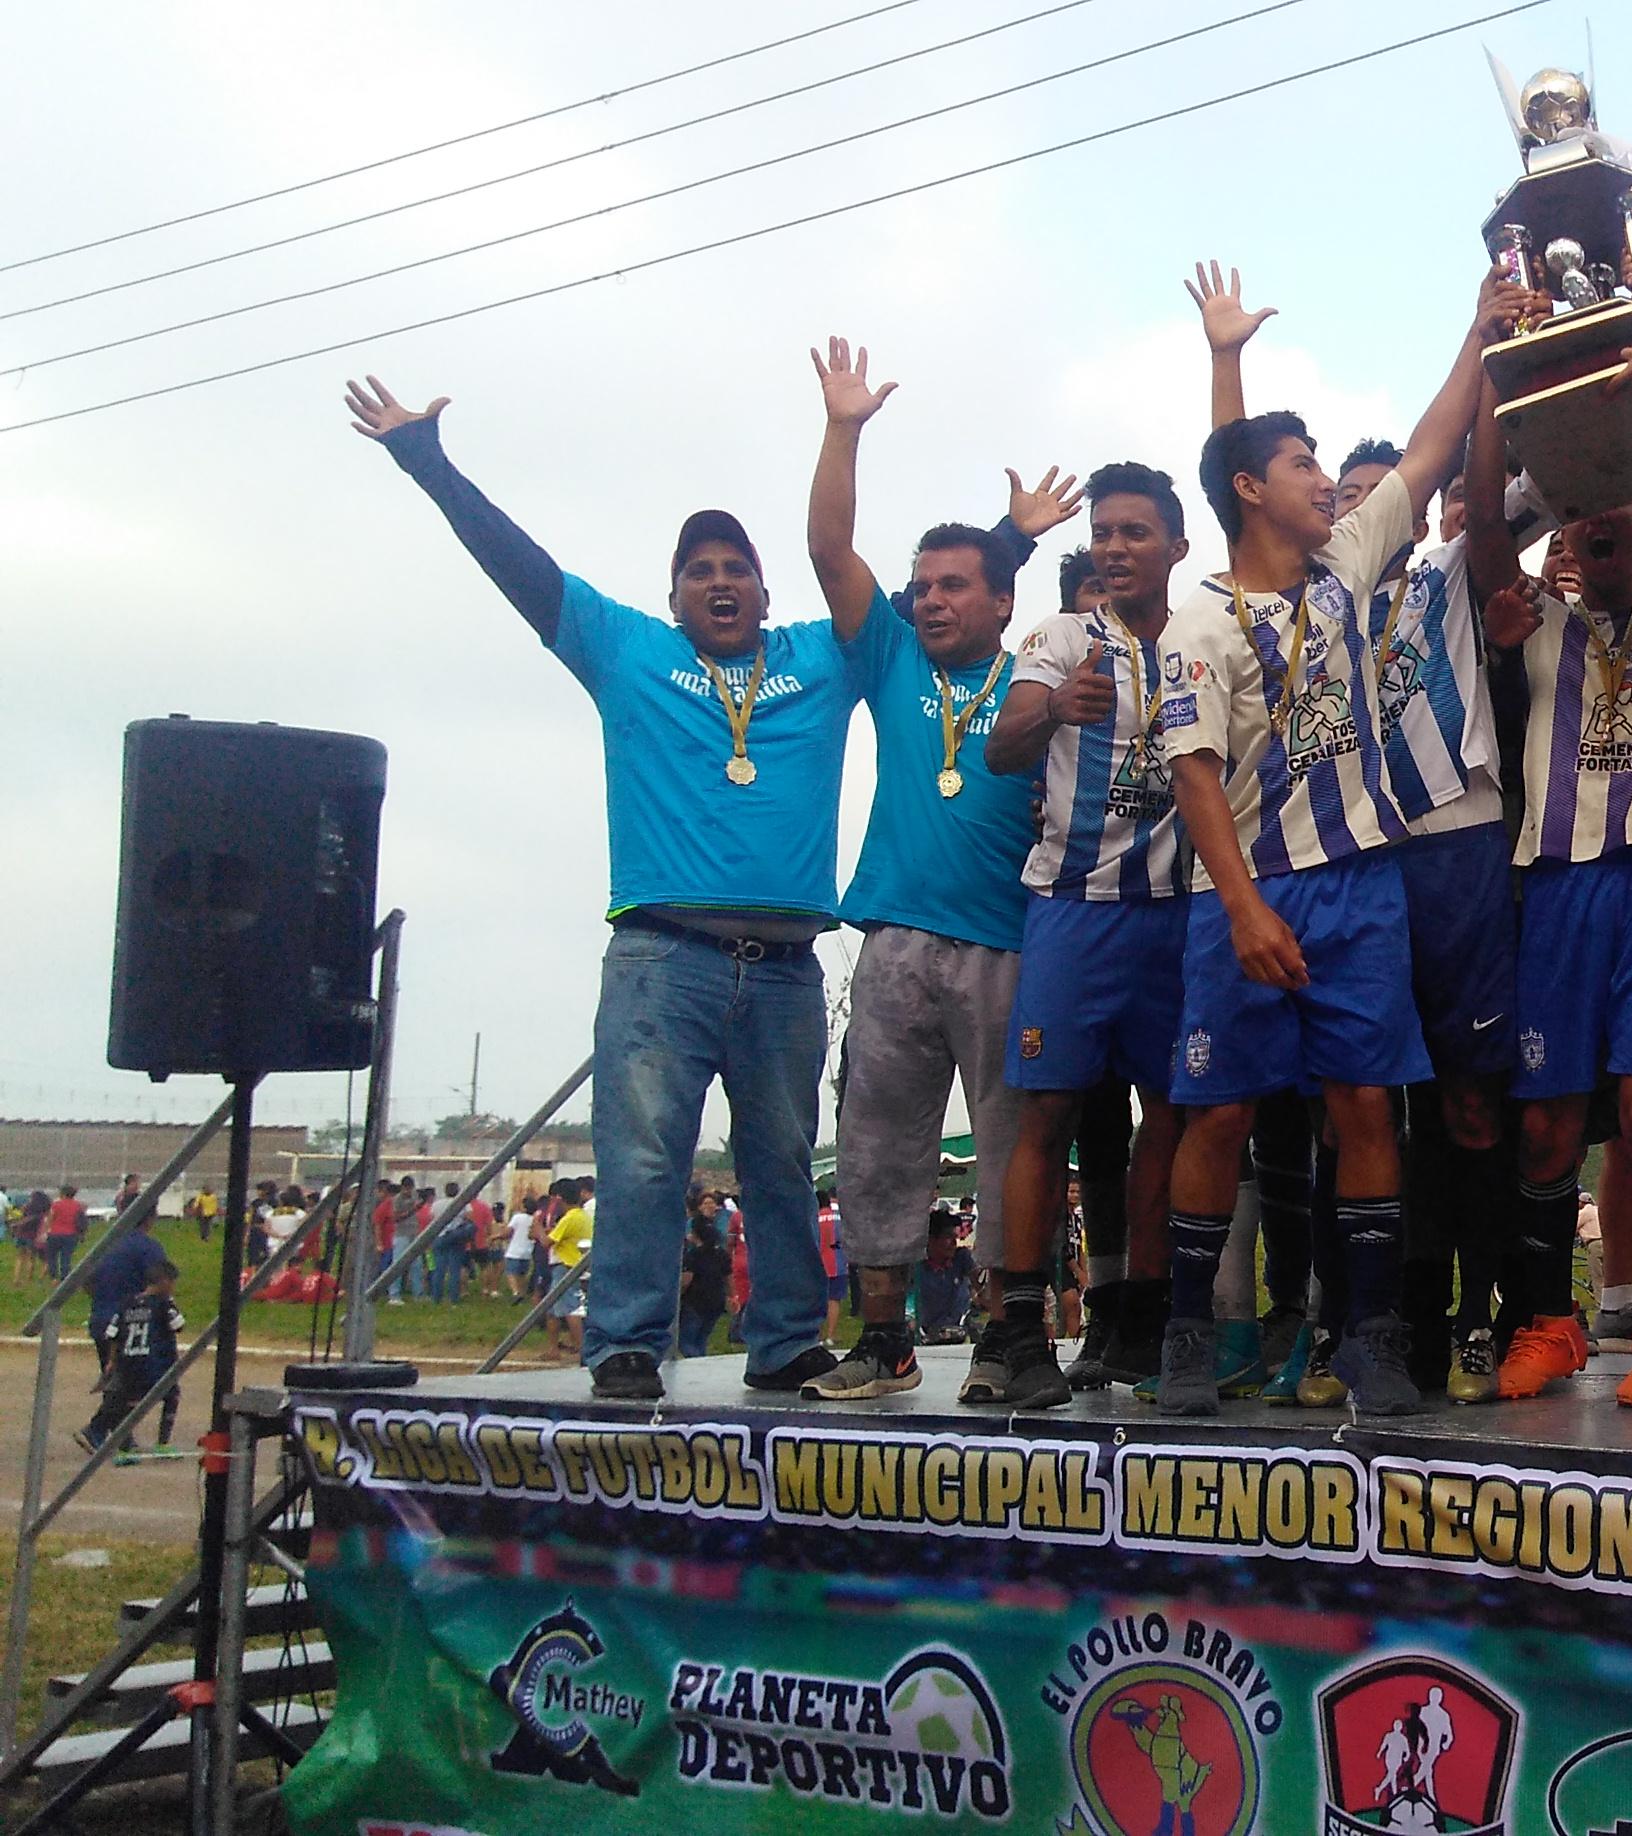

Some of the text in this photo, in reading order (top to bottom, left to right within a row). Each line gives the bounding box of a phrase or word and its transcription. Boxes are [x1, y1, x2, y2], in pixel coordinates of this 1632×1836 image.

[1253, 600, 1286, 624] telcel
[355, 1417, 483, 1488] LIGA
[476, 1423, 558, 1492] DE
[551, 1424, 763, 1512] FUTBOL
[771, 1436, 1106, 1534] MUNICIPAL
[1122, 1451, 1362, 1554] MENOR
[543, 1672, 645, 1729] Mathey
[670, 1663, 892, 1736] PLANETA
[1040, 1612, 1283, 1736] EL POLLO BRAVO
[675, 1719, 1010, 1818] DEPORTIVO
